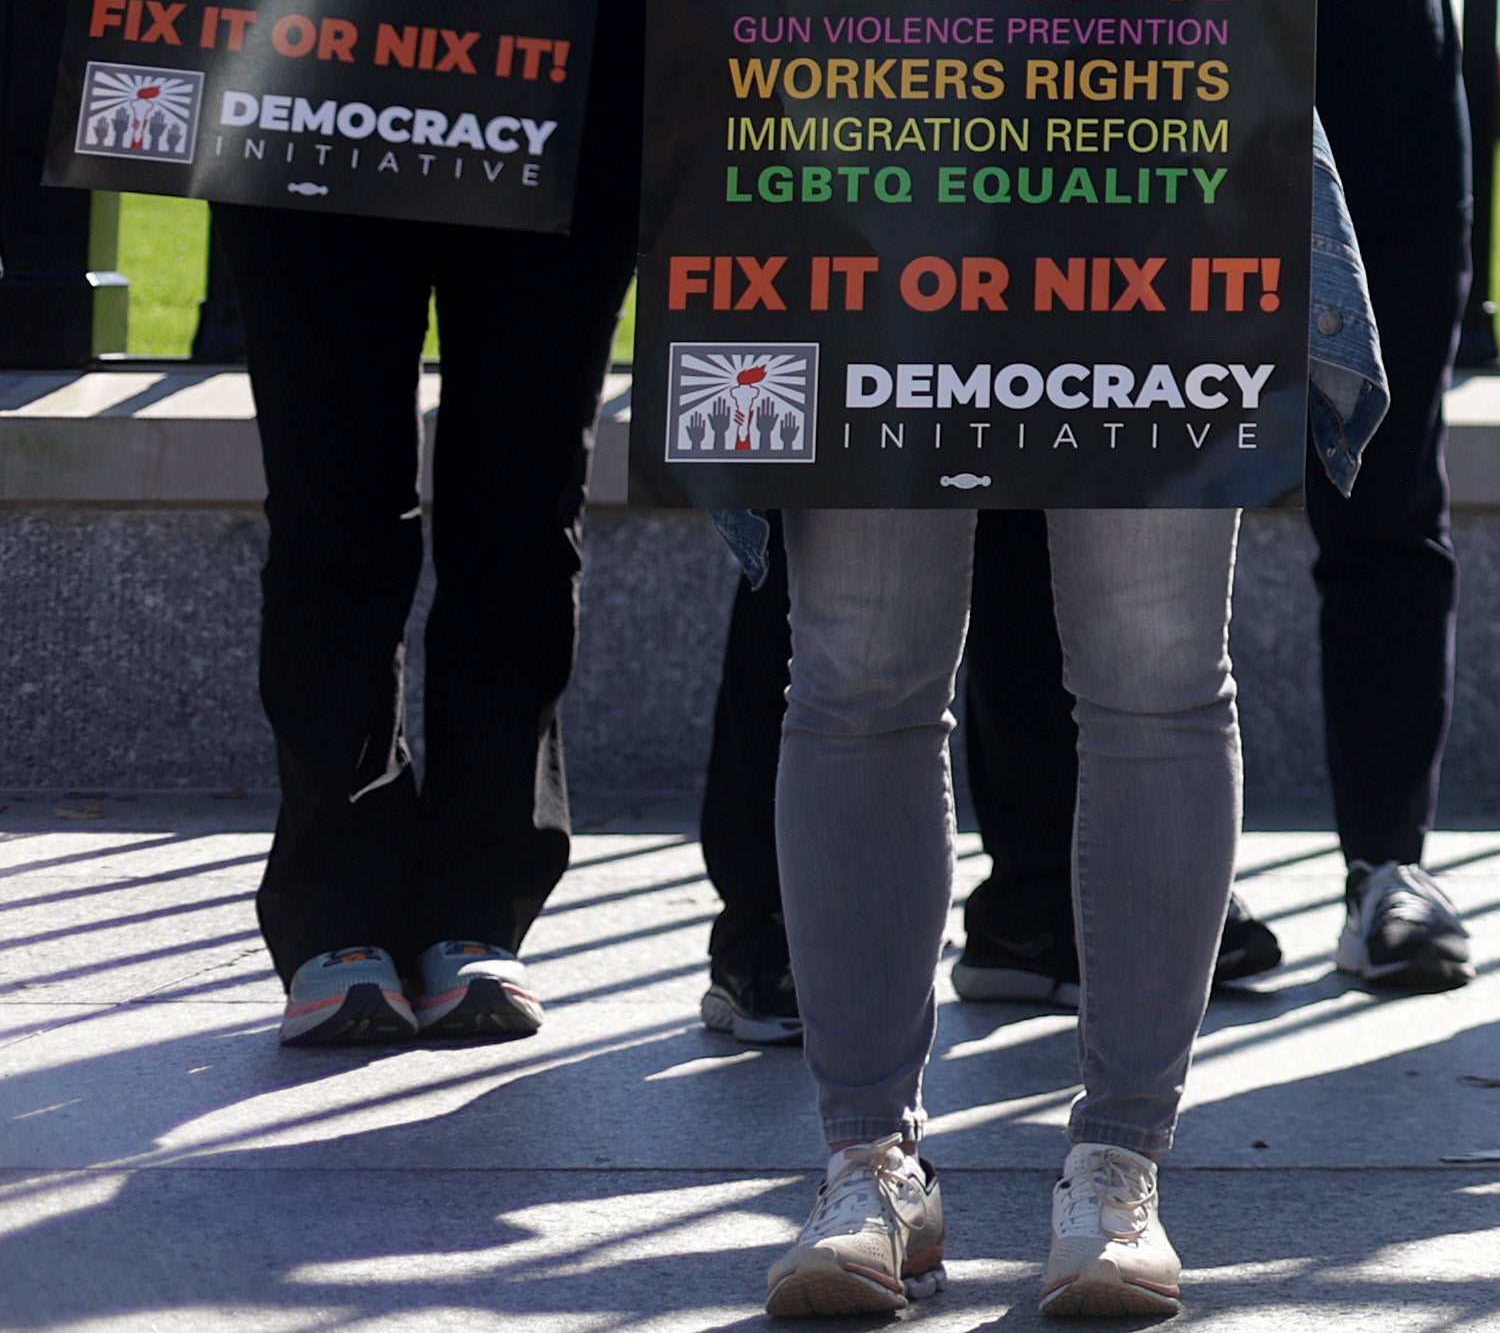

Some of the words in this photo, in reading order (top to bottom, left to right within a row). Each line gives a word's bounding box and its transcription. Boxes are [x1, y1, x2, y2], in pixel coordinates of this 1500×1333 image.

[199, 7, 258, 51] IT
[271, 14, 358, 63] OR
[373, 24, 482, 74] NIX
[494, 35, 571, 83] IT!
[733, 15, 812, 44] GUN
[824, 17, 995, 44] VIOLENCE
[1007, 18, 1228, 46] PREVENTION
[728, 59, 1005, 100] WORKERS
[1026, 59, 1229, 101] RIGHTS
[220, 91, 558, 156] DEMOCRACY
[727, 117, 1029, 152] IMMIGRATION
[1046, 118, 1228, 153] REFORM
[214, 135, 541, 187] INITIATIVE
[726, 166, 912, 203] LGBTQ
[938, 167, 1228, 204] EQUALITY
[668, 255, 788, 311] FIX
[810, 256, 879, 311] IT
[900, 256, 1010, 312] OR
[1033, 257, 1168, 311] NIX
[1189, 257, 1281, 312] IT!
[845, 363, 1275, 410] DEMOCRACY
[843, 423, 1258, 449] INITIATIVE
